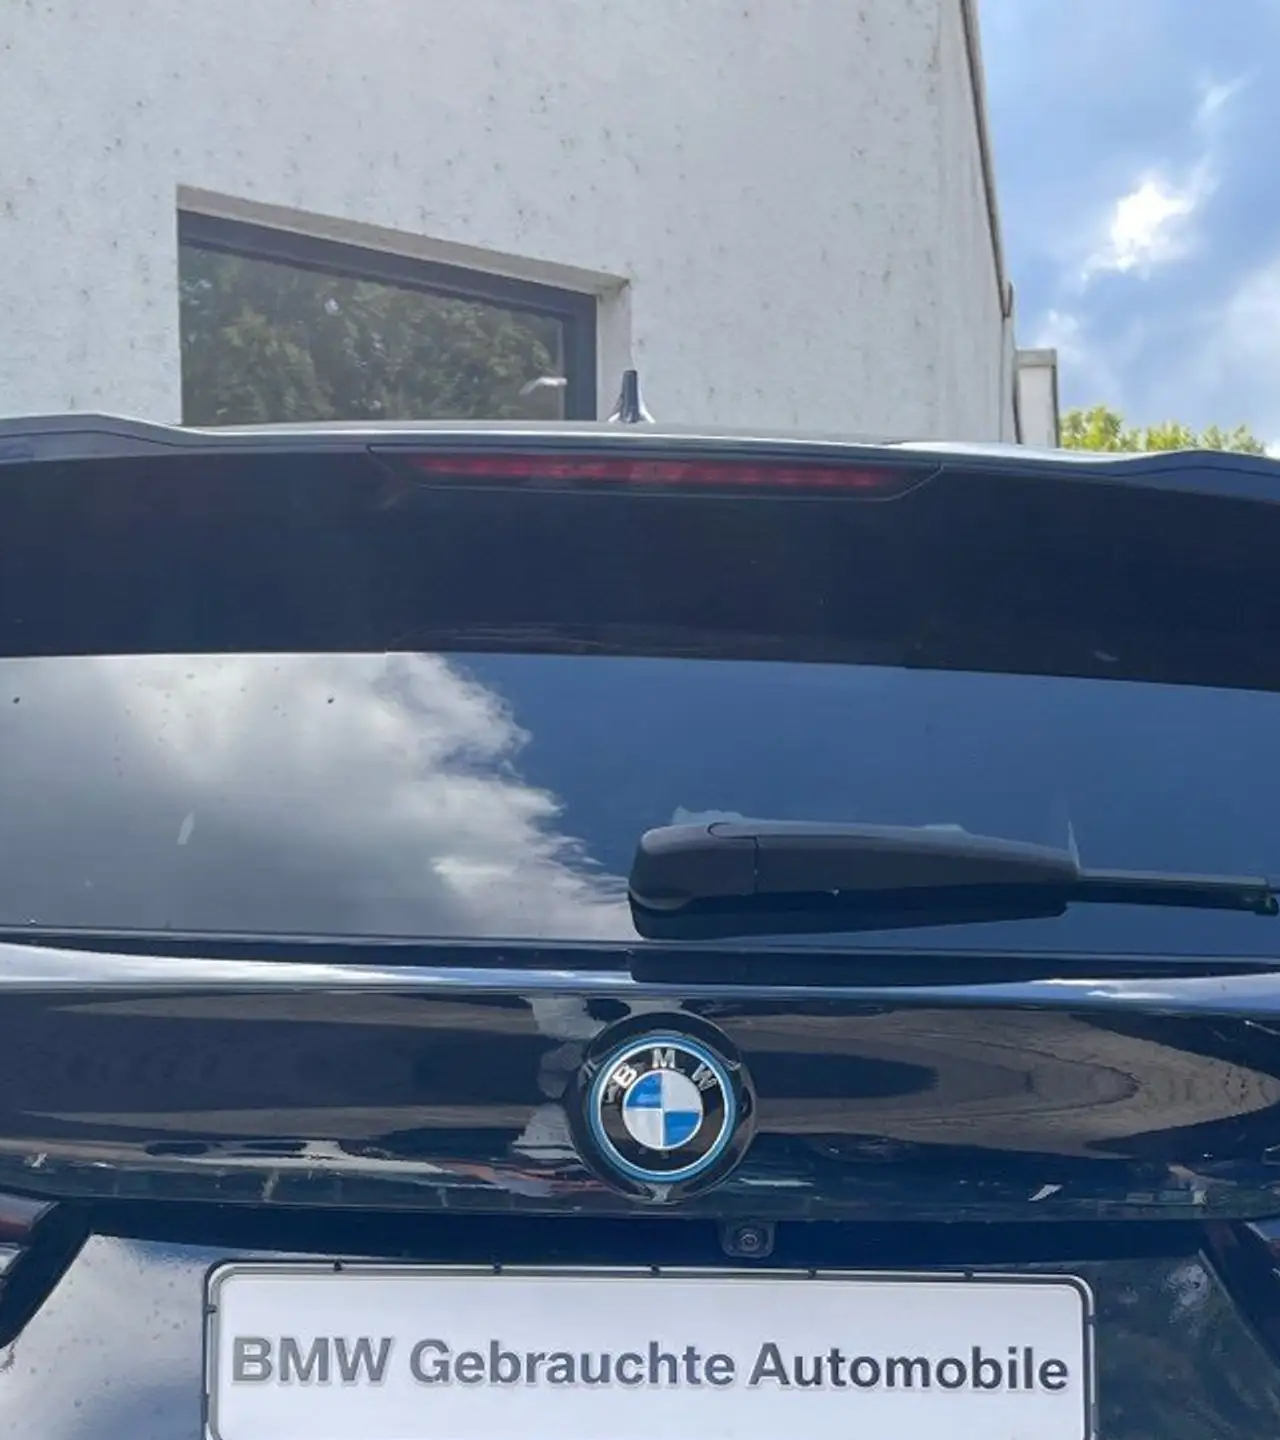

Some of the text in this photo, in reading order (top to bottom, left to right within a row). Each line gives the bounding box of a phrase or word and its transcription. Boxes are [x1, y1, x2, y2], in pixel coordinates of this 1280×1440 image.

[611, 1048, 718, 1092] BMW
[231, 1336, 1069, 1390] BMW Gebrauchte Automobile
